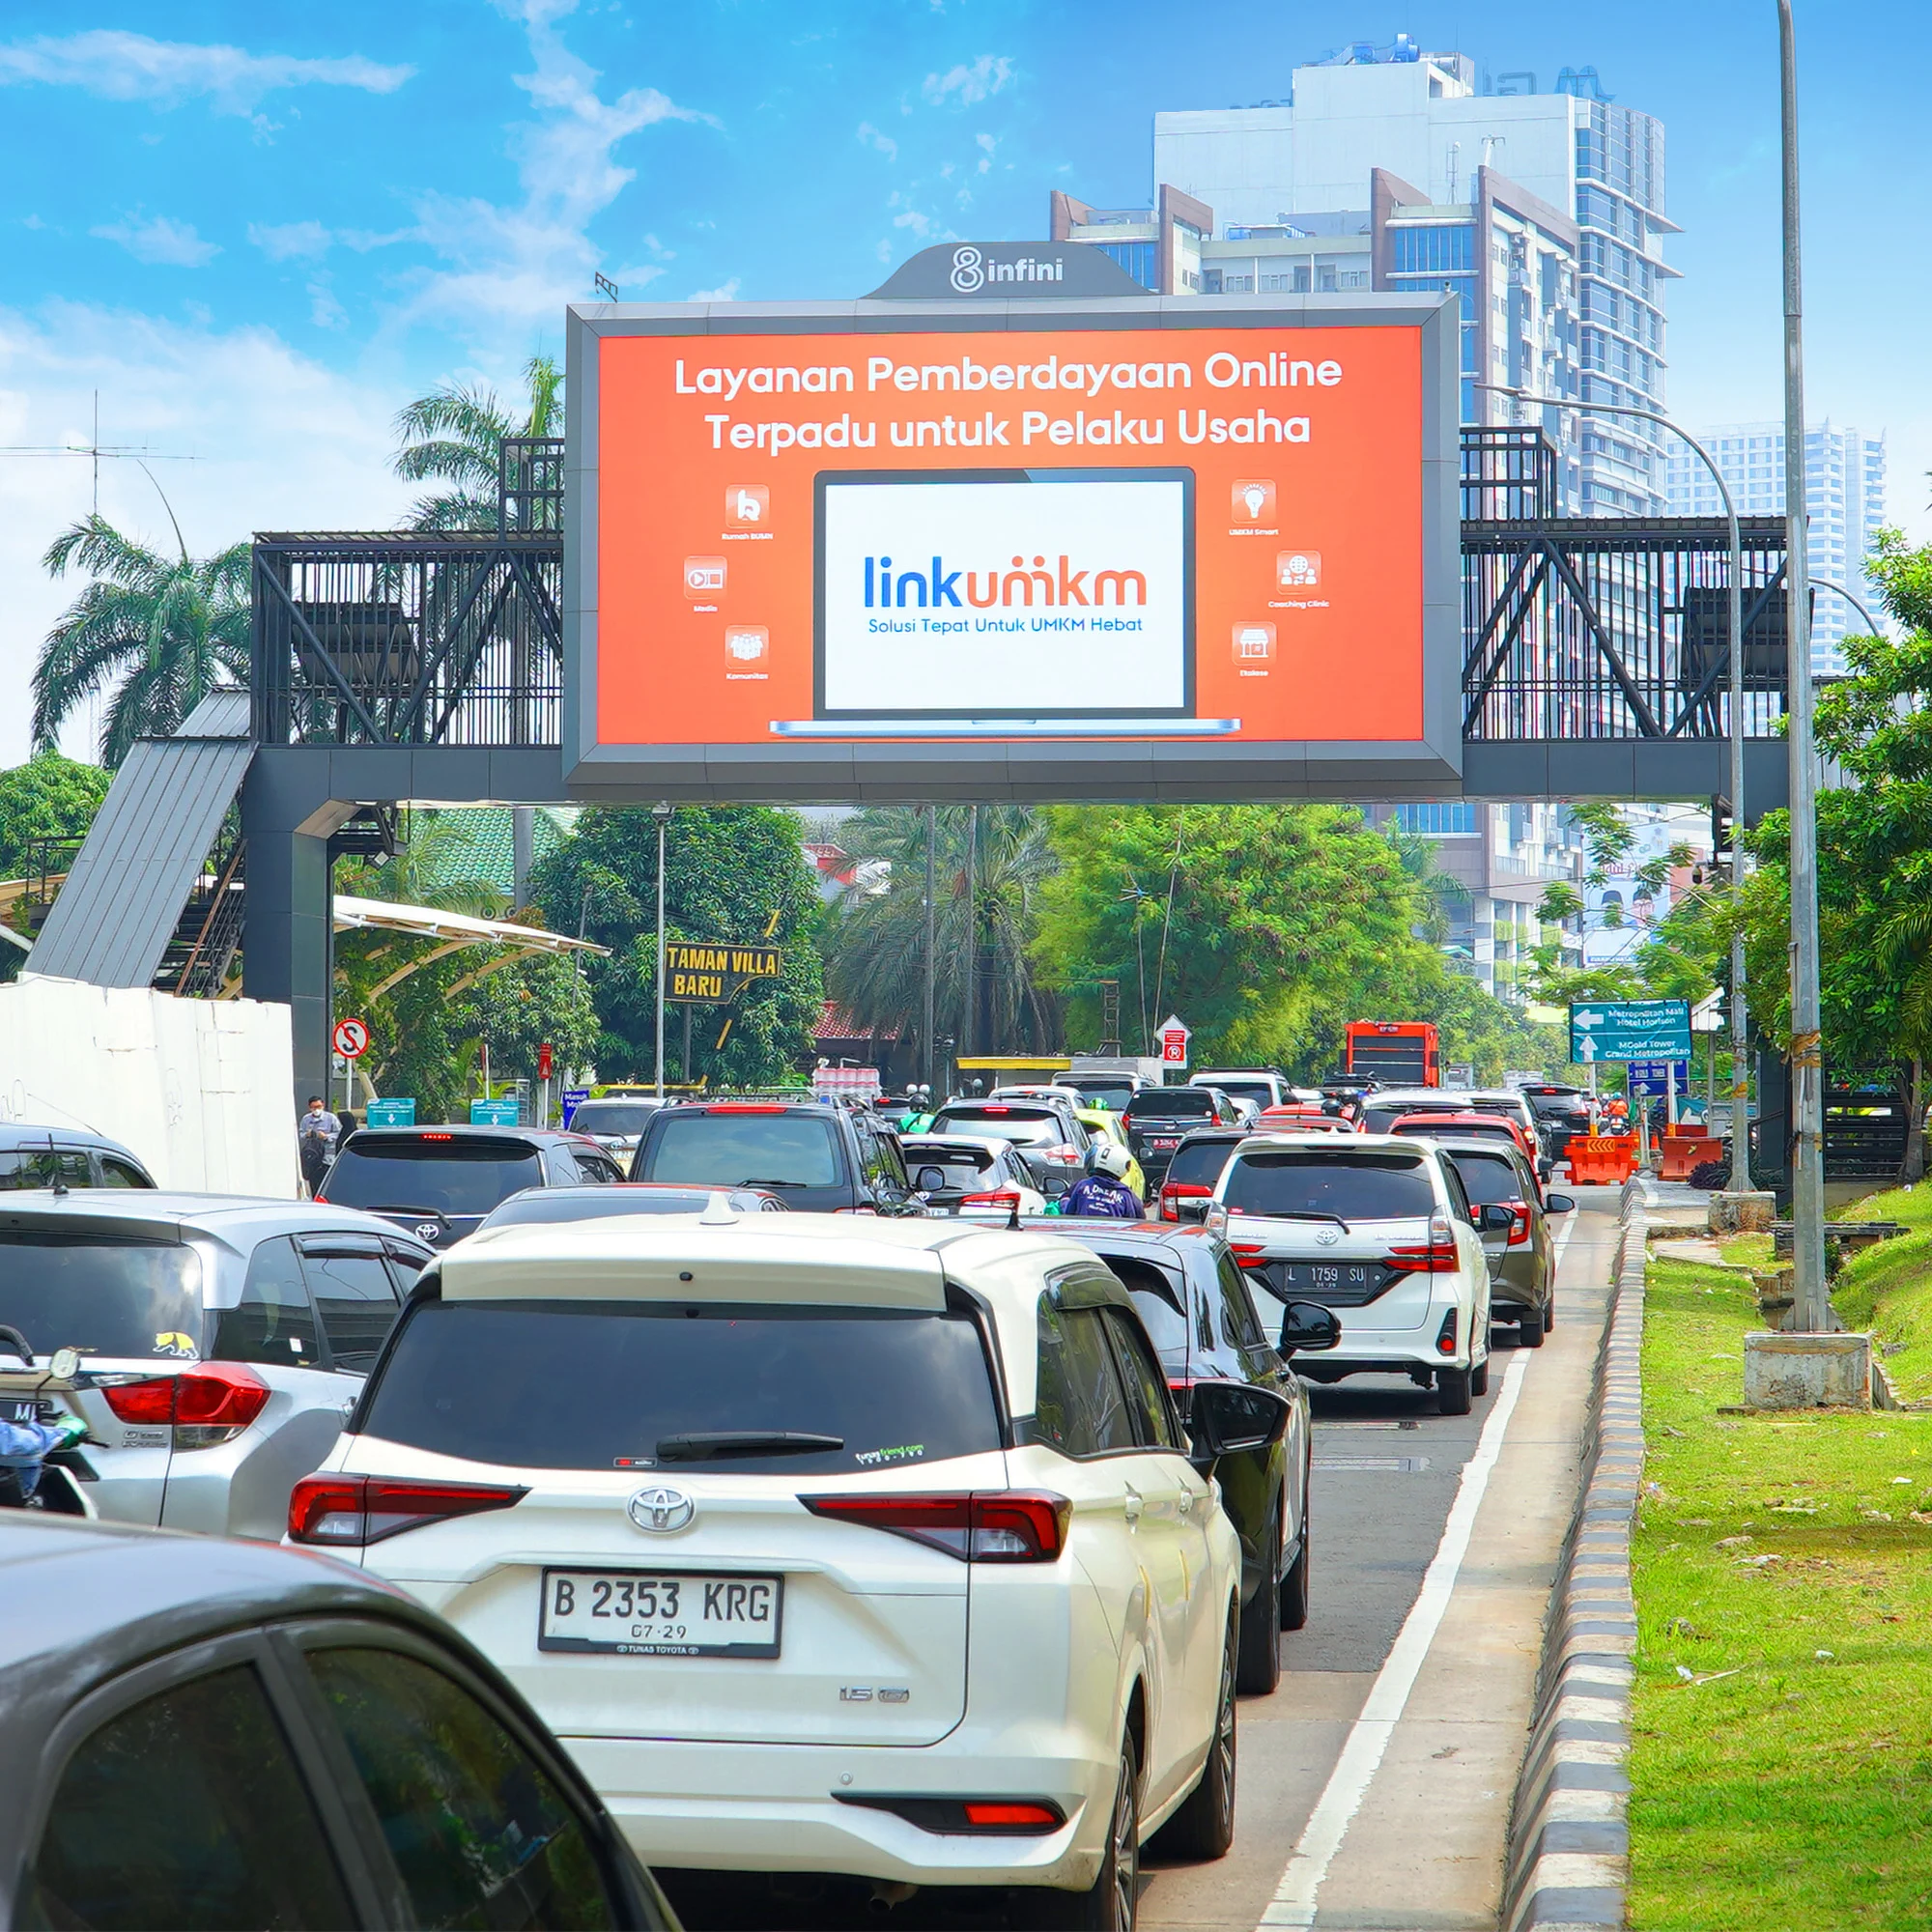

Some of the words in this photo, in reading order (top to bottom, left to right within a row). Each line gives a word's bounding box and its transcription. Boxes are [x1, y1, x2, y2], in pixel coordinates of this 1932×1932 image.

[988, 258, 1063, 282] infini
[675, 359, 854, 401] Layanan
[867, 355, 1192, 397] Pemberdayaan
[1204, 352, 1343, 388] Online
[704, 412, 876, 457] Terpadu
[890, 412, 1010, 447] untuk
[1022, 410, 1164, 445] Pelaku
[1178, 408, 1311, 444] Usaha
[1267, 600, 1306, 610] Coaching
[868, 618, 916, 634] Solusi
[922, 618, 970, 636] Tepat
[976, 618, 1025, 633] Untuk
[1031, 616, 1085, 633] UMKM
[1091, 616, 1143, 632] Hebat
[668, 947, 728, 972] TAMAN
[731, 951, 776, 975] VILLA
[673, 973, 722, 998] BARU
[1608, 1009, 1664, 1019] Metropolitan
[1617, 1017, 1641, 1027] Hotel
[1649, 1040, 1676, 1049] Tower
[1605, 1050, 1633, 1059] Grand
[1288, 1266, 1296, 1281] L
[1312, 1267, 1339, 1282] 1759
[1350, 1267, 1365, 1282] SU
[554, 1579, 576, 1616] B
[591, 1580, 680, 1619] 2353
[703, 1582, 770, 1622] KRG
[628, 1645, 655, 1654] TUNAS
[656, 1646, 687, 1655] TOYOTA
